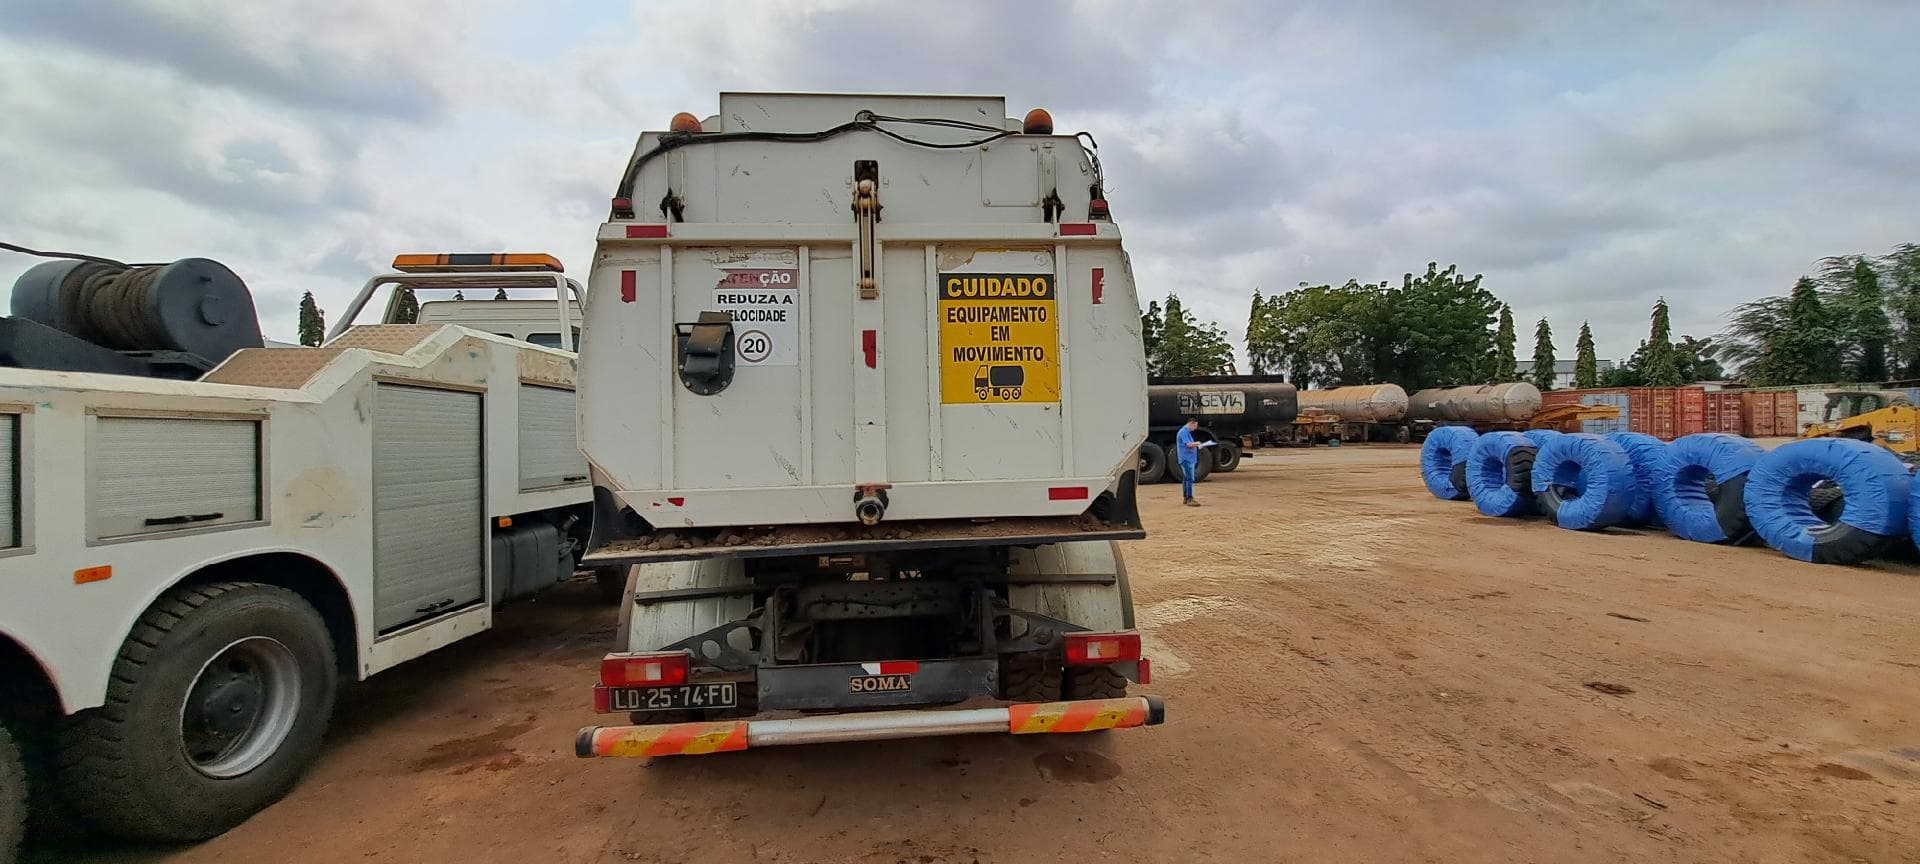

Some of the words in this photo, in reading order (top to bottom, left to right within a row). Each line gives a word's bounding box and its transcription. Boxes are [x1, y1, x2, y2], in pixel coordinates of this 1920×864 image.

[947, 278, 1047, 297] CUIDADO
[717, 294, 778, 304] REDUZA
[782, 294, 793, 304] A
[947, 306, 1047, 324] EQUIPAMENTO
[991, 325, 1010, 341] EM
[744, 339, 765, 353] 20
[953, 346, 1044, 362] MOVIMENTO
[1180, 394, 1242, 408] ENGEVIA
[851, 676, 909, 692] SOMA
